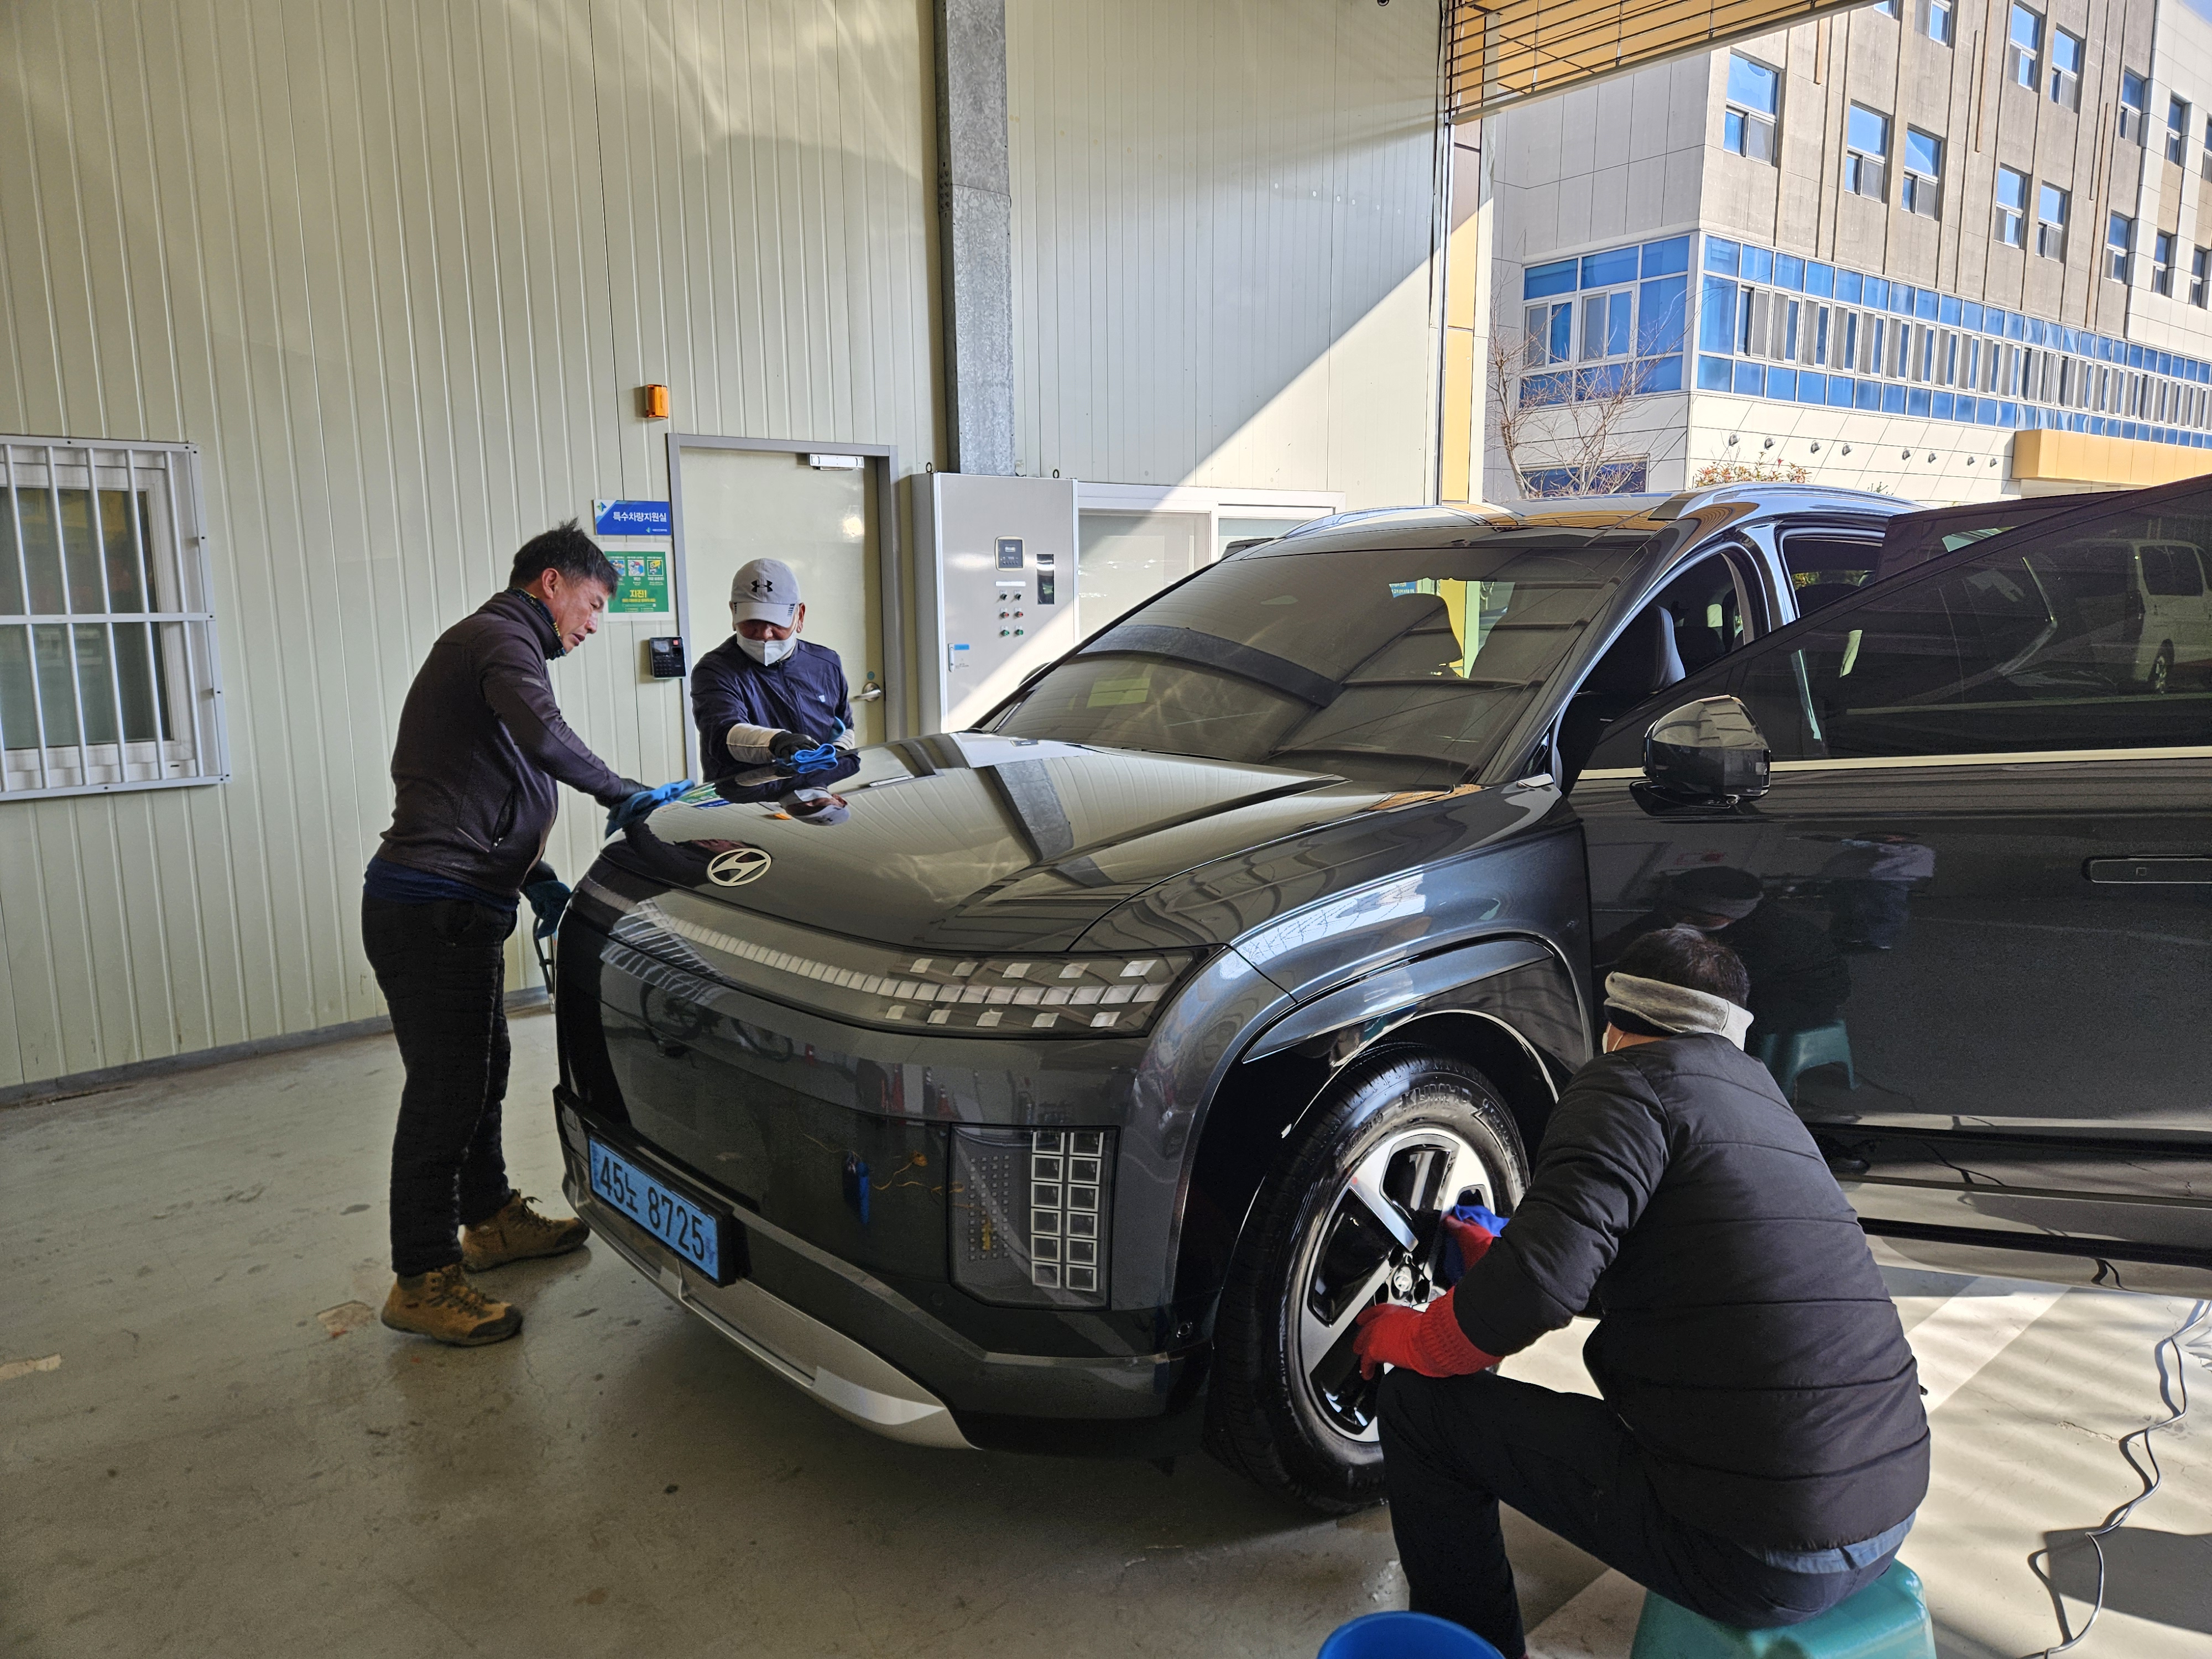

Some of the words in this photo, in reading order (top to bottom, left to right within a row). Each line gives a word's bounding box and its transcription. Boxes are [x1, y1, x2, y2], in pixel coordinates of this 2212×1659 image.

[613, 511, 667, 522] 특수차량지원실
[1400, 1083, 1472, 1110] KUMHO
[600, 1156, 639, 1213] 45노
[648, 1186, 705, 1261] 8725
